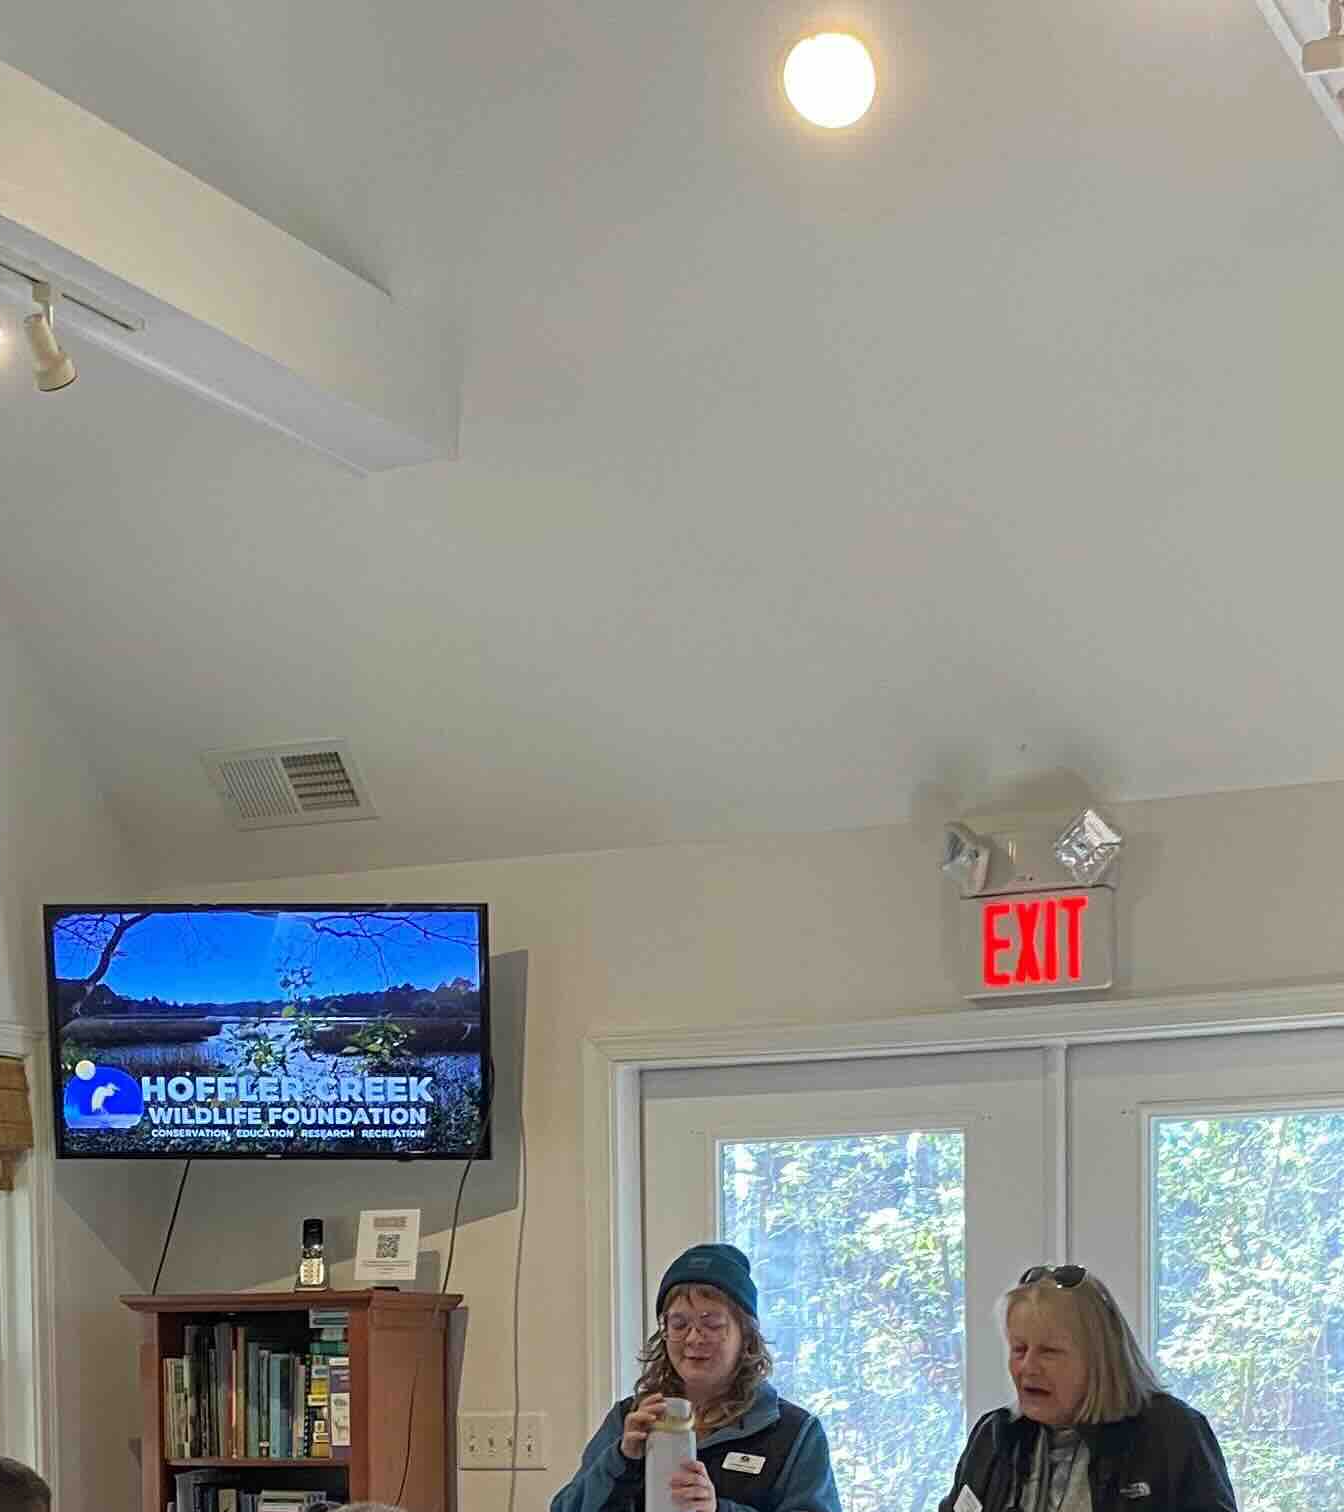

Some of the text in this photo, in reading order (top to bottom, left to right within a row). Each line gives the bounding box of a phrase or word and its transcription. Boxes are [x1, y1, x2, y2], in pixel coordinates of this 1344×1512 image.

[983, 896, 1088, 988] EXIT
[141, 1076, 434, 1102] HOFFLER CREEK
[148, 1107, 427, 1125] WILDLIFE FOUNDATION
[151, 1128, 425, 1138] CONSERVATION EDUCATION RESEARCH RECREATION
